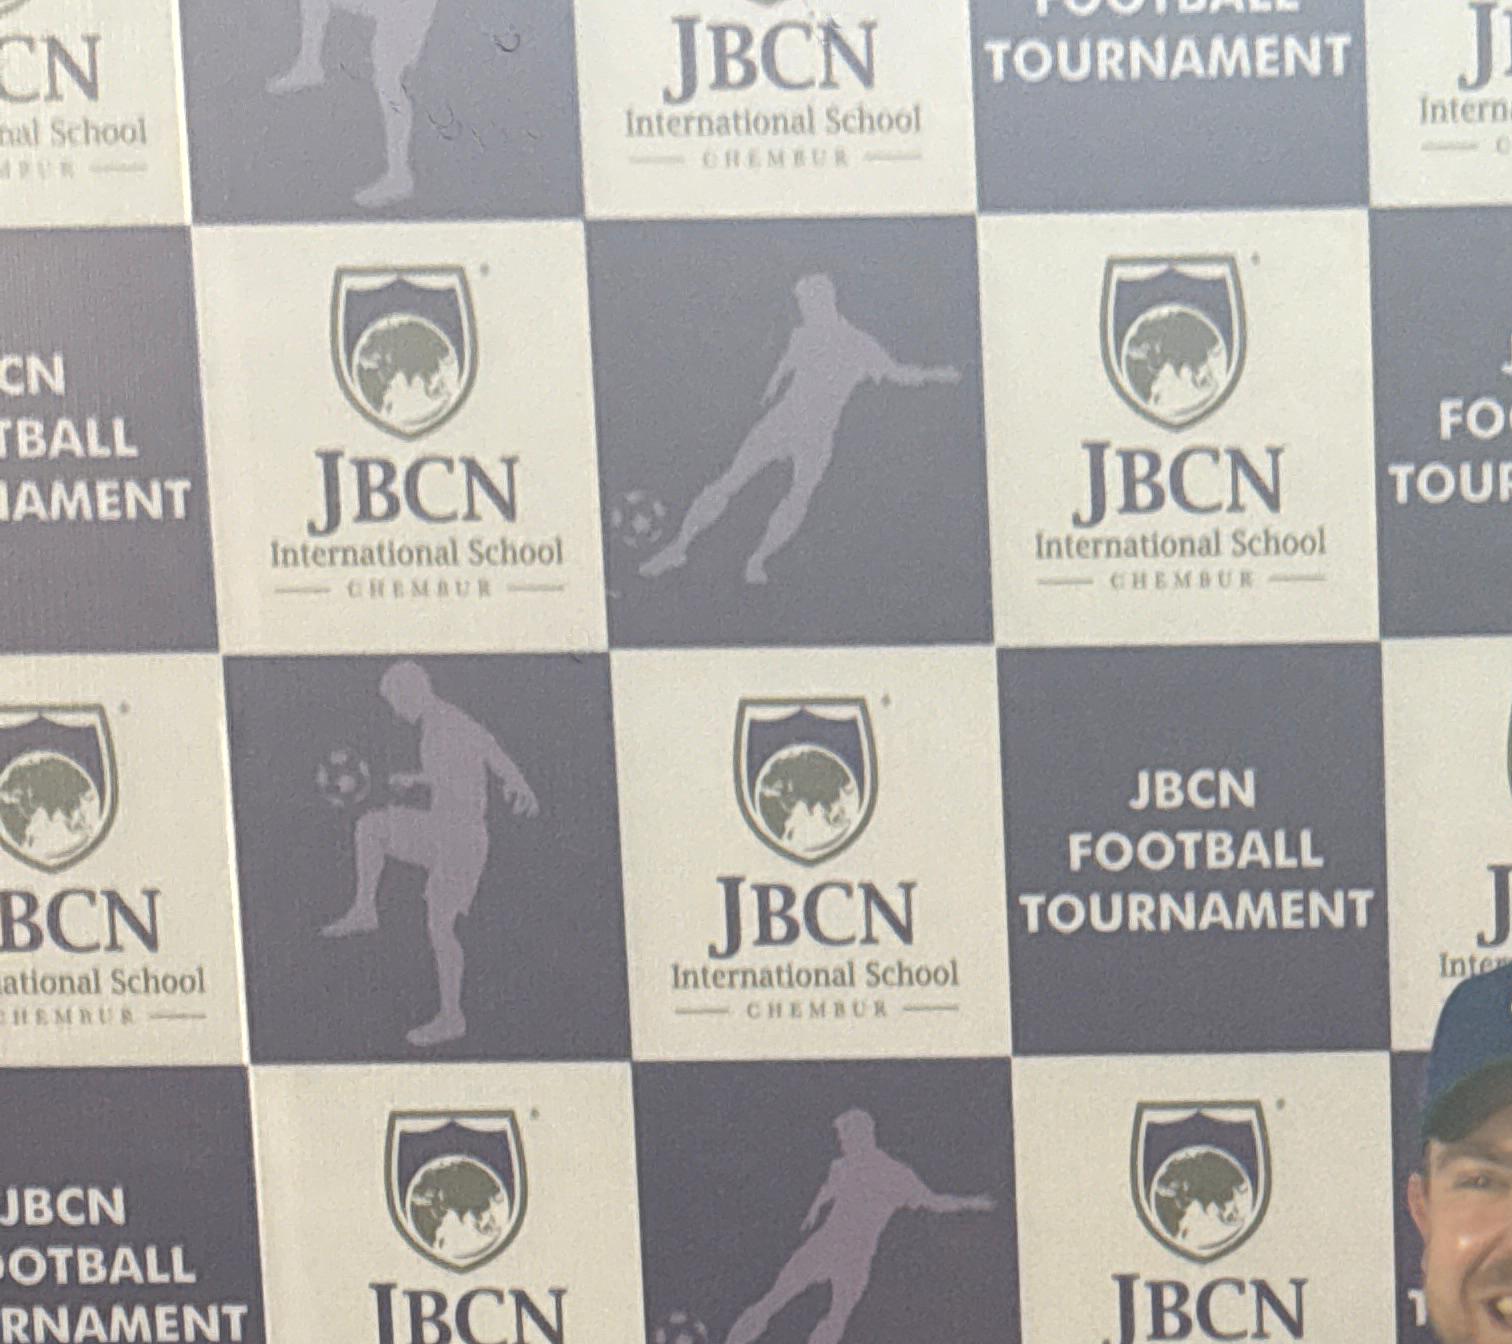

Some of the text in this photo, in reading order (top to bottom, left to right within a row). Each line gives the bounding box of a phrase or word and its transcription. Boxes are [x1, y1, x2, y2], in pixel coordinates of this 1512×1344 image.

[663, 15, 877, 105] JBCN
[985, 34, 1351, 81] TOURNAMENT
[51, 117, 147, 146] School
[626, 103, 921, 137] International School
[307, 450, 518, 537] JBCN
[1072, 441, 1284, 528] JBCN
[271, 536, 563, 568] International School
[1036, 526, 1326, 559] International School
[1130, 769, 1255, 809] JBCN
[1069, 829, 1323, 871] FOOTBALL
[0, 888, 160, 953] BCN
[708, 876, 916, 959] JBCN
[1019, 890, 1374, 933] TOURNAMENT
[111, 966, 205, 995] School
[672, 959, 959, 989] International School
